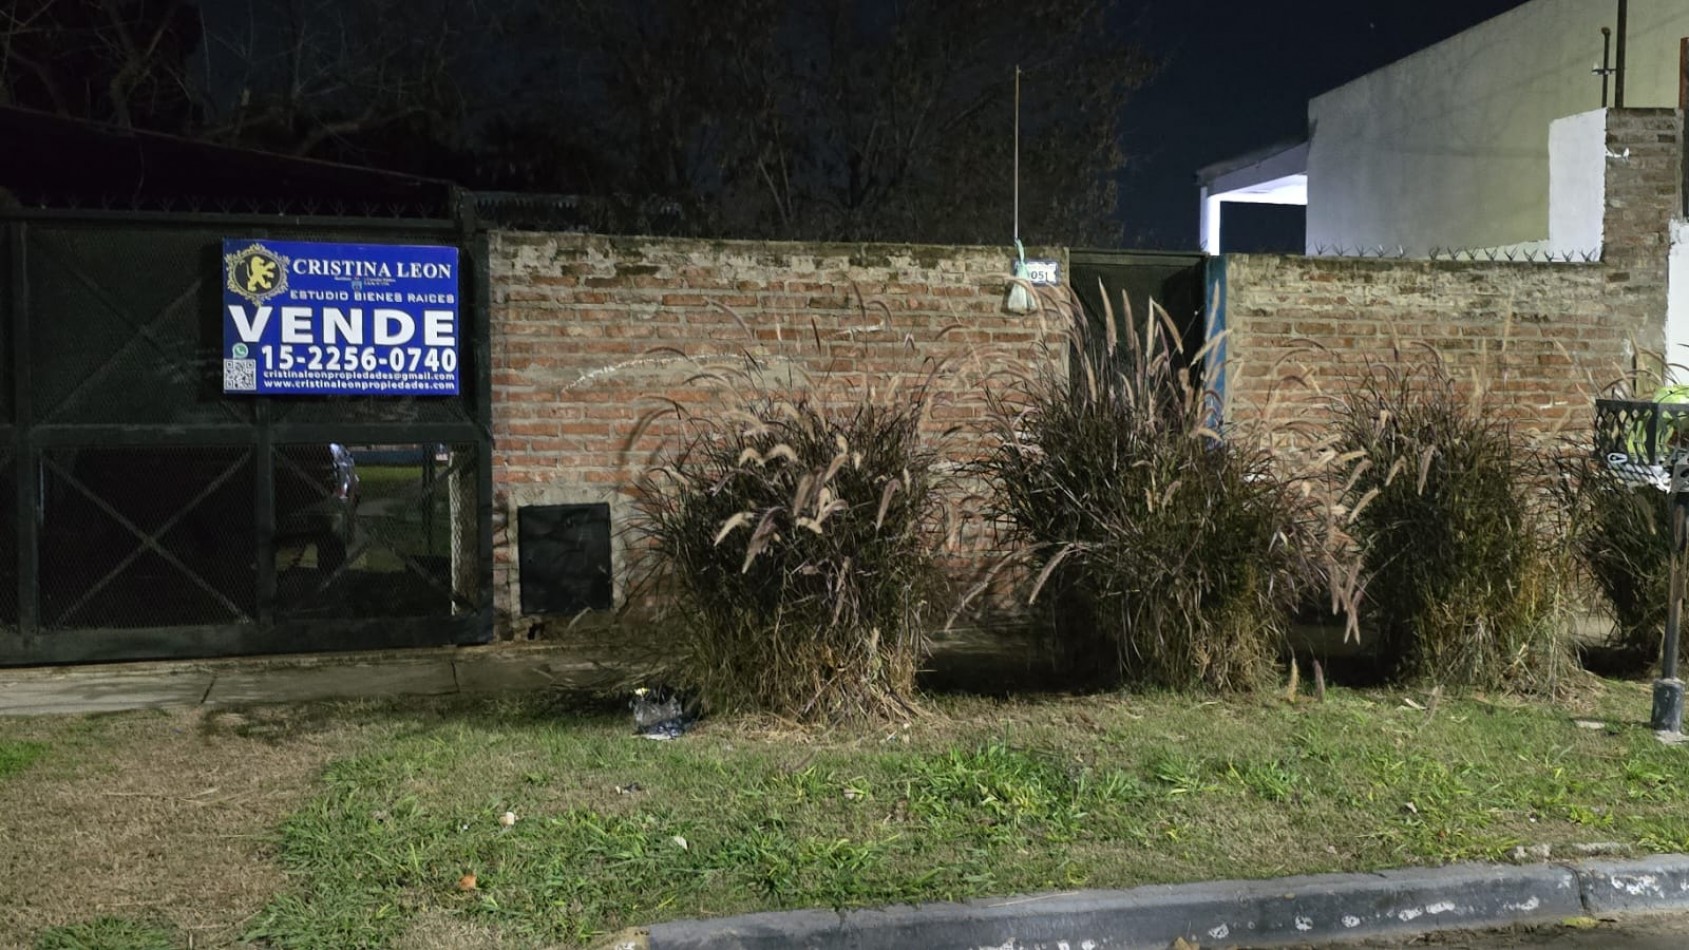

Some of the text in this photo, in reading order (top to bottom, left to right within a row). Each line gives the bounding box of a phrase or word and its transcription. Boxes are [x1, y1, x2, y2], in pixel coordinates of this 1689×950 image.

[292, 259, 452, 279] CRISTINA LEON
[290, 289, 455, 304] ESTUDIO BIENES RAICES
[228, 305, 456, 346] VENDE
[261, 345, 457, 372] 15-2256-0740
[263, 370, 455, 381] cristinaleonpropiedades@gmail.com
[263, 379, 455, 391] www.cristinaleonpropiedades.com
